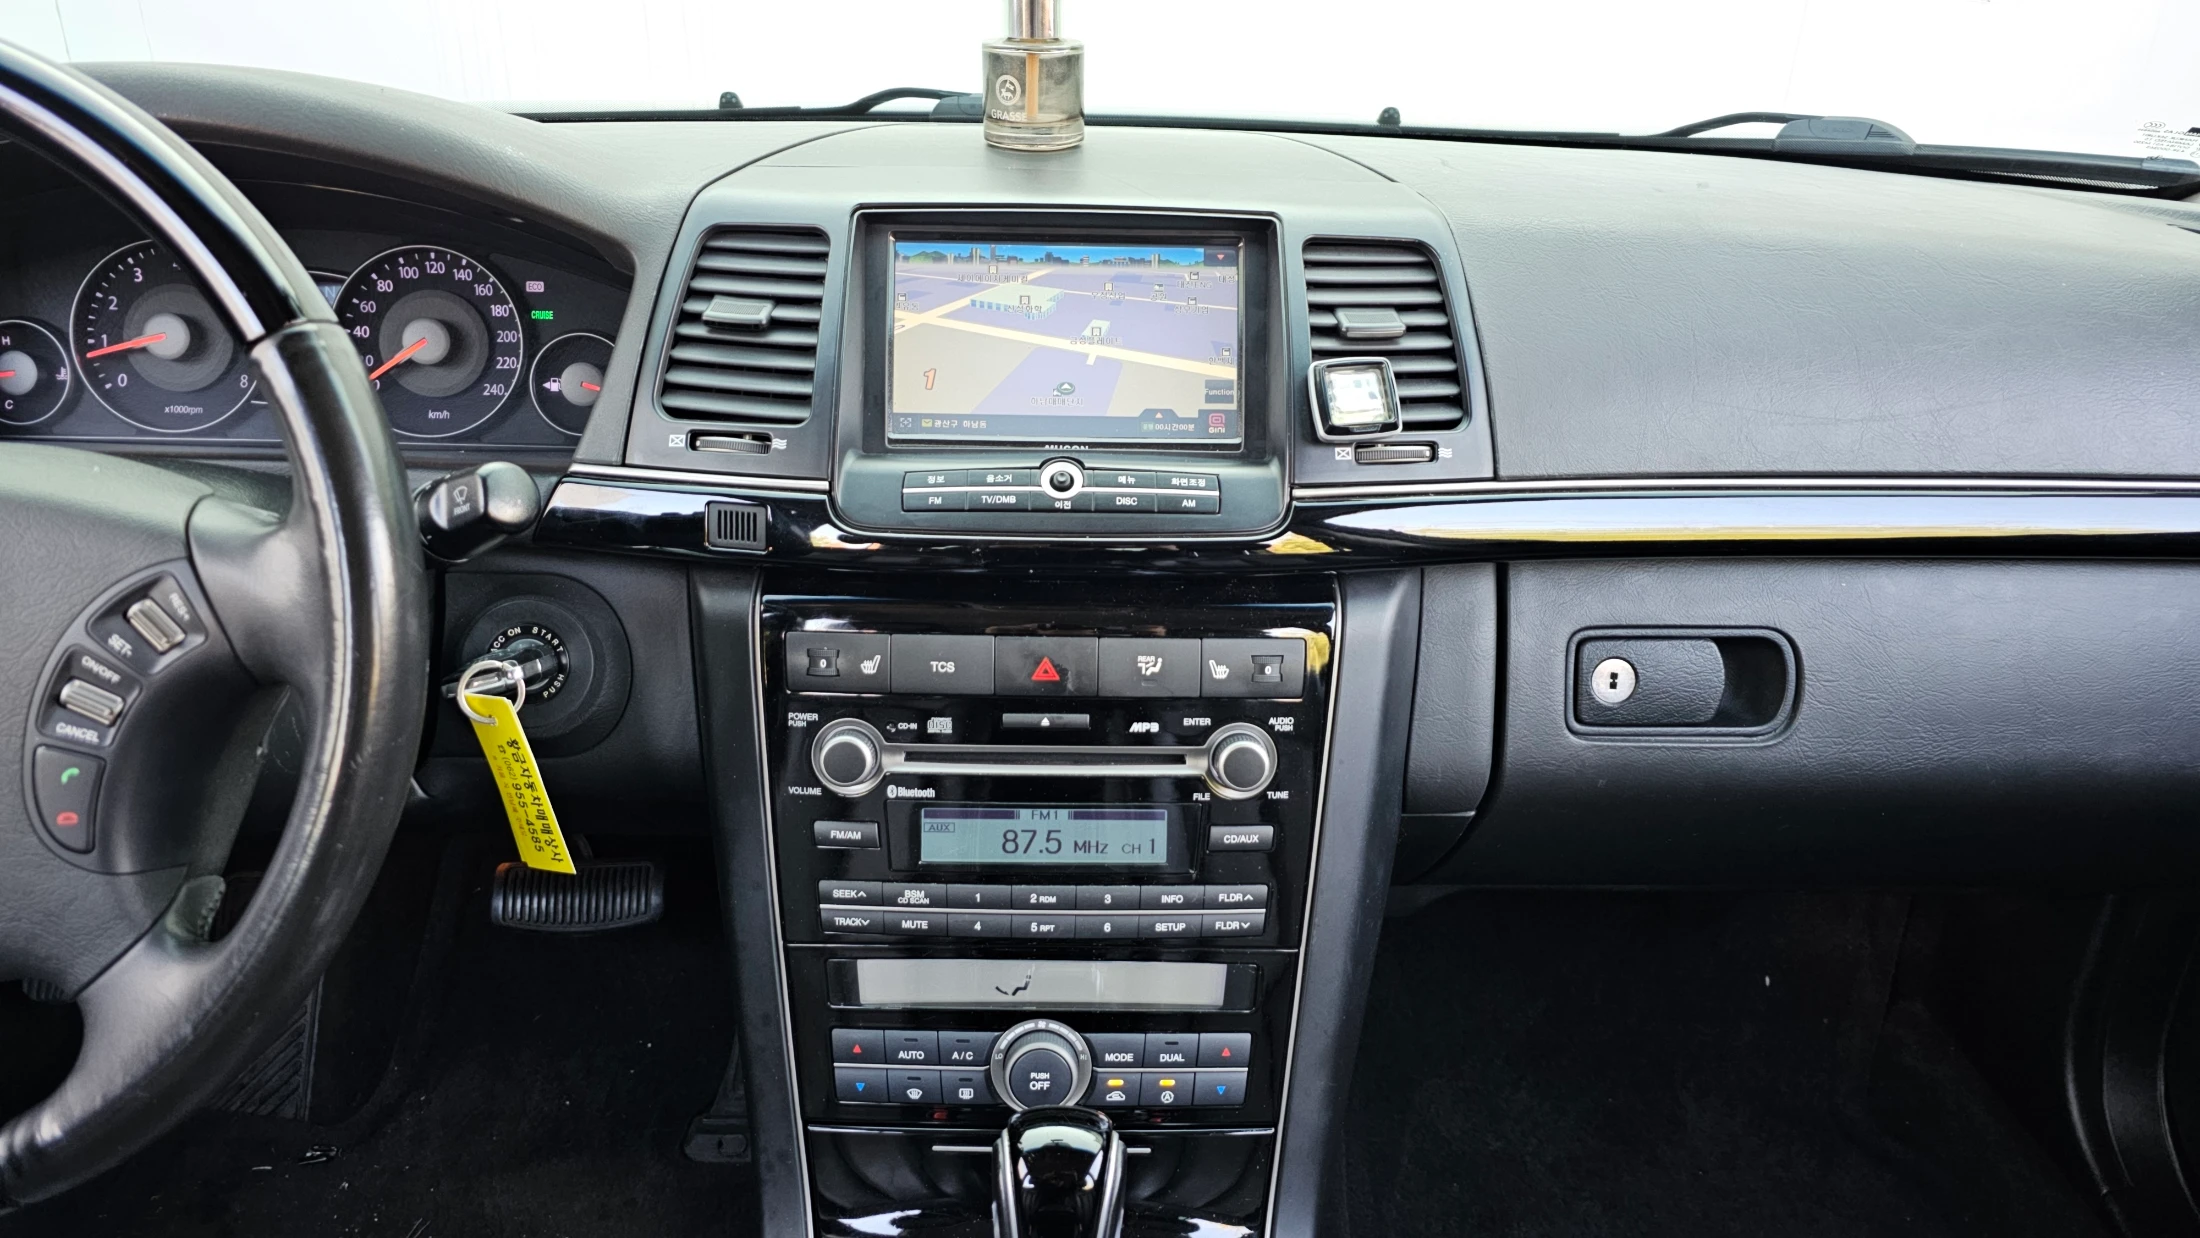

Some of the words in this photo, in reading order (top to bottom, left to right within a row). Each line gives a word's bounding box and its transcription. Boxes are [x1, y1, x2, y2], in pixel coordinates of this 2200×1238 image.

[991, 109, 1028, 121] GRASSE
[399, 266, 419, 279] 100
[425, 261, 445, 274] 120
[134, 268, 143, 282] 3
[452, 269, 473, 281] 140
[377, 280, 393, 292] 80
[474, 283, 493, 296] 160
[528, 283, 543, 291] ECO
[325, 286, 336, 297] N
[108, 296, 118, 310] 2
[360, 301, 377, 313] 60
[490, 304, 510, 317] 180
[531, 310, 554, 320] CRUISE
[353, 325, 370, 338] 40
[1, 336, 11, 346] H
[101, 334, 108, 347] 1
[496, 331, 518, 343] 200
[496, 356, 517, 369] 220
[117, 373, 128, 386] 0
[240, 374, 248, 388] 8
[923, 368, 937, 390] 1
[483, 384, 505, 397] 240
[4, 400, 14, 409] C
[164, 405, 203, 415] x1000rpm
[428, 410, 450, 420] km/h
[934, 420, 958, 428] 광산구
[927, 475, 945, 484] 정보
[986, 474, 1013, 483] 음소거
[1118, 475, 1136, 485] 메뉴
[1171, 477, 1206, 487] 화면조정
[928, 496, 942, 505] FM
[981, 495, 1016, 504] TV/DMB
[1116, 497, 1138, 506] DISC
[1182, 499, 1196, 507] AM
[453, 503, 471, 516] FRONT
[1055, 501, 1072, 510] 이전
[507, 626, 522, 637] ON
[532, 626, 564, 652] START
[81, 655, 121, 684] ON/OFF
[930, 661, 955, 673] TCS
[543, 673, 565, 698] PUSH
[788, 712, 818, 721] POWER
[1183, 717, 1211, 726] ENTER
[1268, 717, 1294, 725] AUDIO
[897, 722, 918, 730] CD-IN
[1129, 722, 1160, 733] MP3
[56, 722, 100, 742] CANCEL
[788, 786, 822, 795] VOLUME
[897, 786, 936, 798] Bluetooth
[1267, 791, 1289, 800] TUNE
[506, 737, 564, 863] 황금자동차매매상사
[1193, 792, 1211, 801] FILE
[502, 757, 518, 781] (062)
[512, 783, 545, 853] 955-4585
[929, 823, 950, 832] AUX
[830, 830, 862, 840] FM/AM
[1224, 835, 1259, 844] CD/AUX
[1001, 829, 1062, 854] 87.5
[1073, 840, 1108, 854] MHz
[1121, 843, 1141, 854] CH
[1149, 838, 1155, 854] 1
[833, 889, 858, 898] SEEK
[904, 890, 925, 899] BSM
[975, 893, 981, 903] 1
[1030, 893, 1038, 903] 2
[1039, 896, 1057, 904] RDM
[1219, 893, 1243, 902] FLDR
[898, 897, 908, 905] CD
[909, 897, 930, 905] SCAN
[1104, 894, 1111, 904] 3
[1161, 894, 1184, 904] INFO
[834, 917, 862, 926] TRACK
[902, 920, 929, 930] MUTE
[974, 922, 981, 931] 4
[1215, 921, 1240, 930] FLDR
[1030, 923, 1038, 932] 5
[1104, 923, 1111, 933] 6
[1155, 922, 1186, 932] SETUP
[898, 1051, 925, 1060] AUTO
[1105, 1053, 1134, 1062] MODE
[1159, 1053, 1185, 1062] DUAL
[1030, 1072, 1050, 1080] PUSH
[1029, 1081, 1050, 1091] OFF
